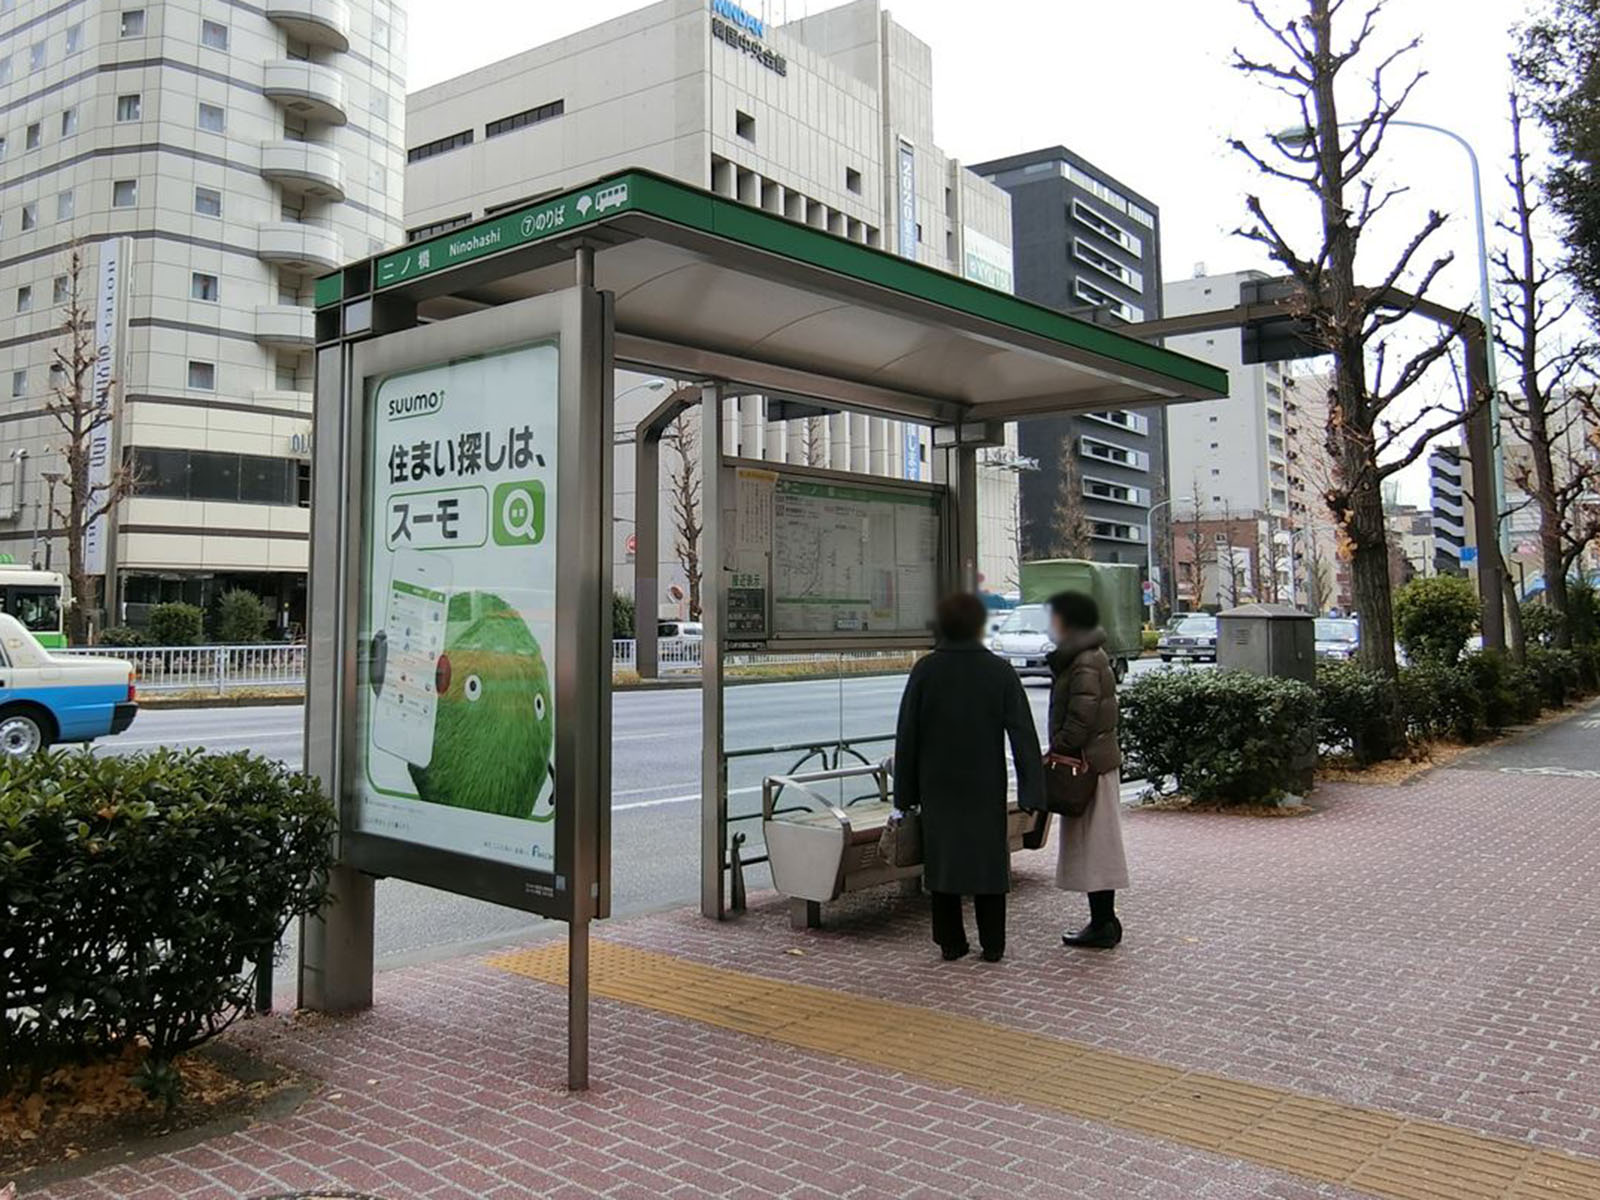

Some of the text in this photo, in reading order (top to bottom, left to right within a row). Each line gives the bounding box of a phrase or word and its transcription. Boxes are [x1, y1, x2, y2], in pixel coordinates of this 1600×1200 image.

[449, 228, 501, 257] Ninohashi
[382, 249, 431, 280] 二ノ橋
[104, 260, 116, 331] HOTEL
[388, 425, 546, 485] 住まい探しは、
[391, 499, 459, 542] スーモ
